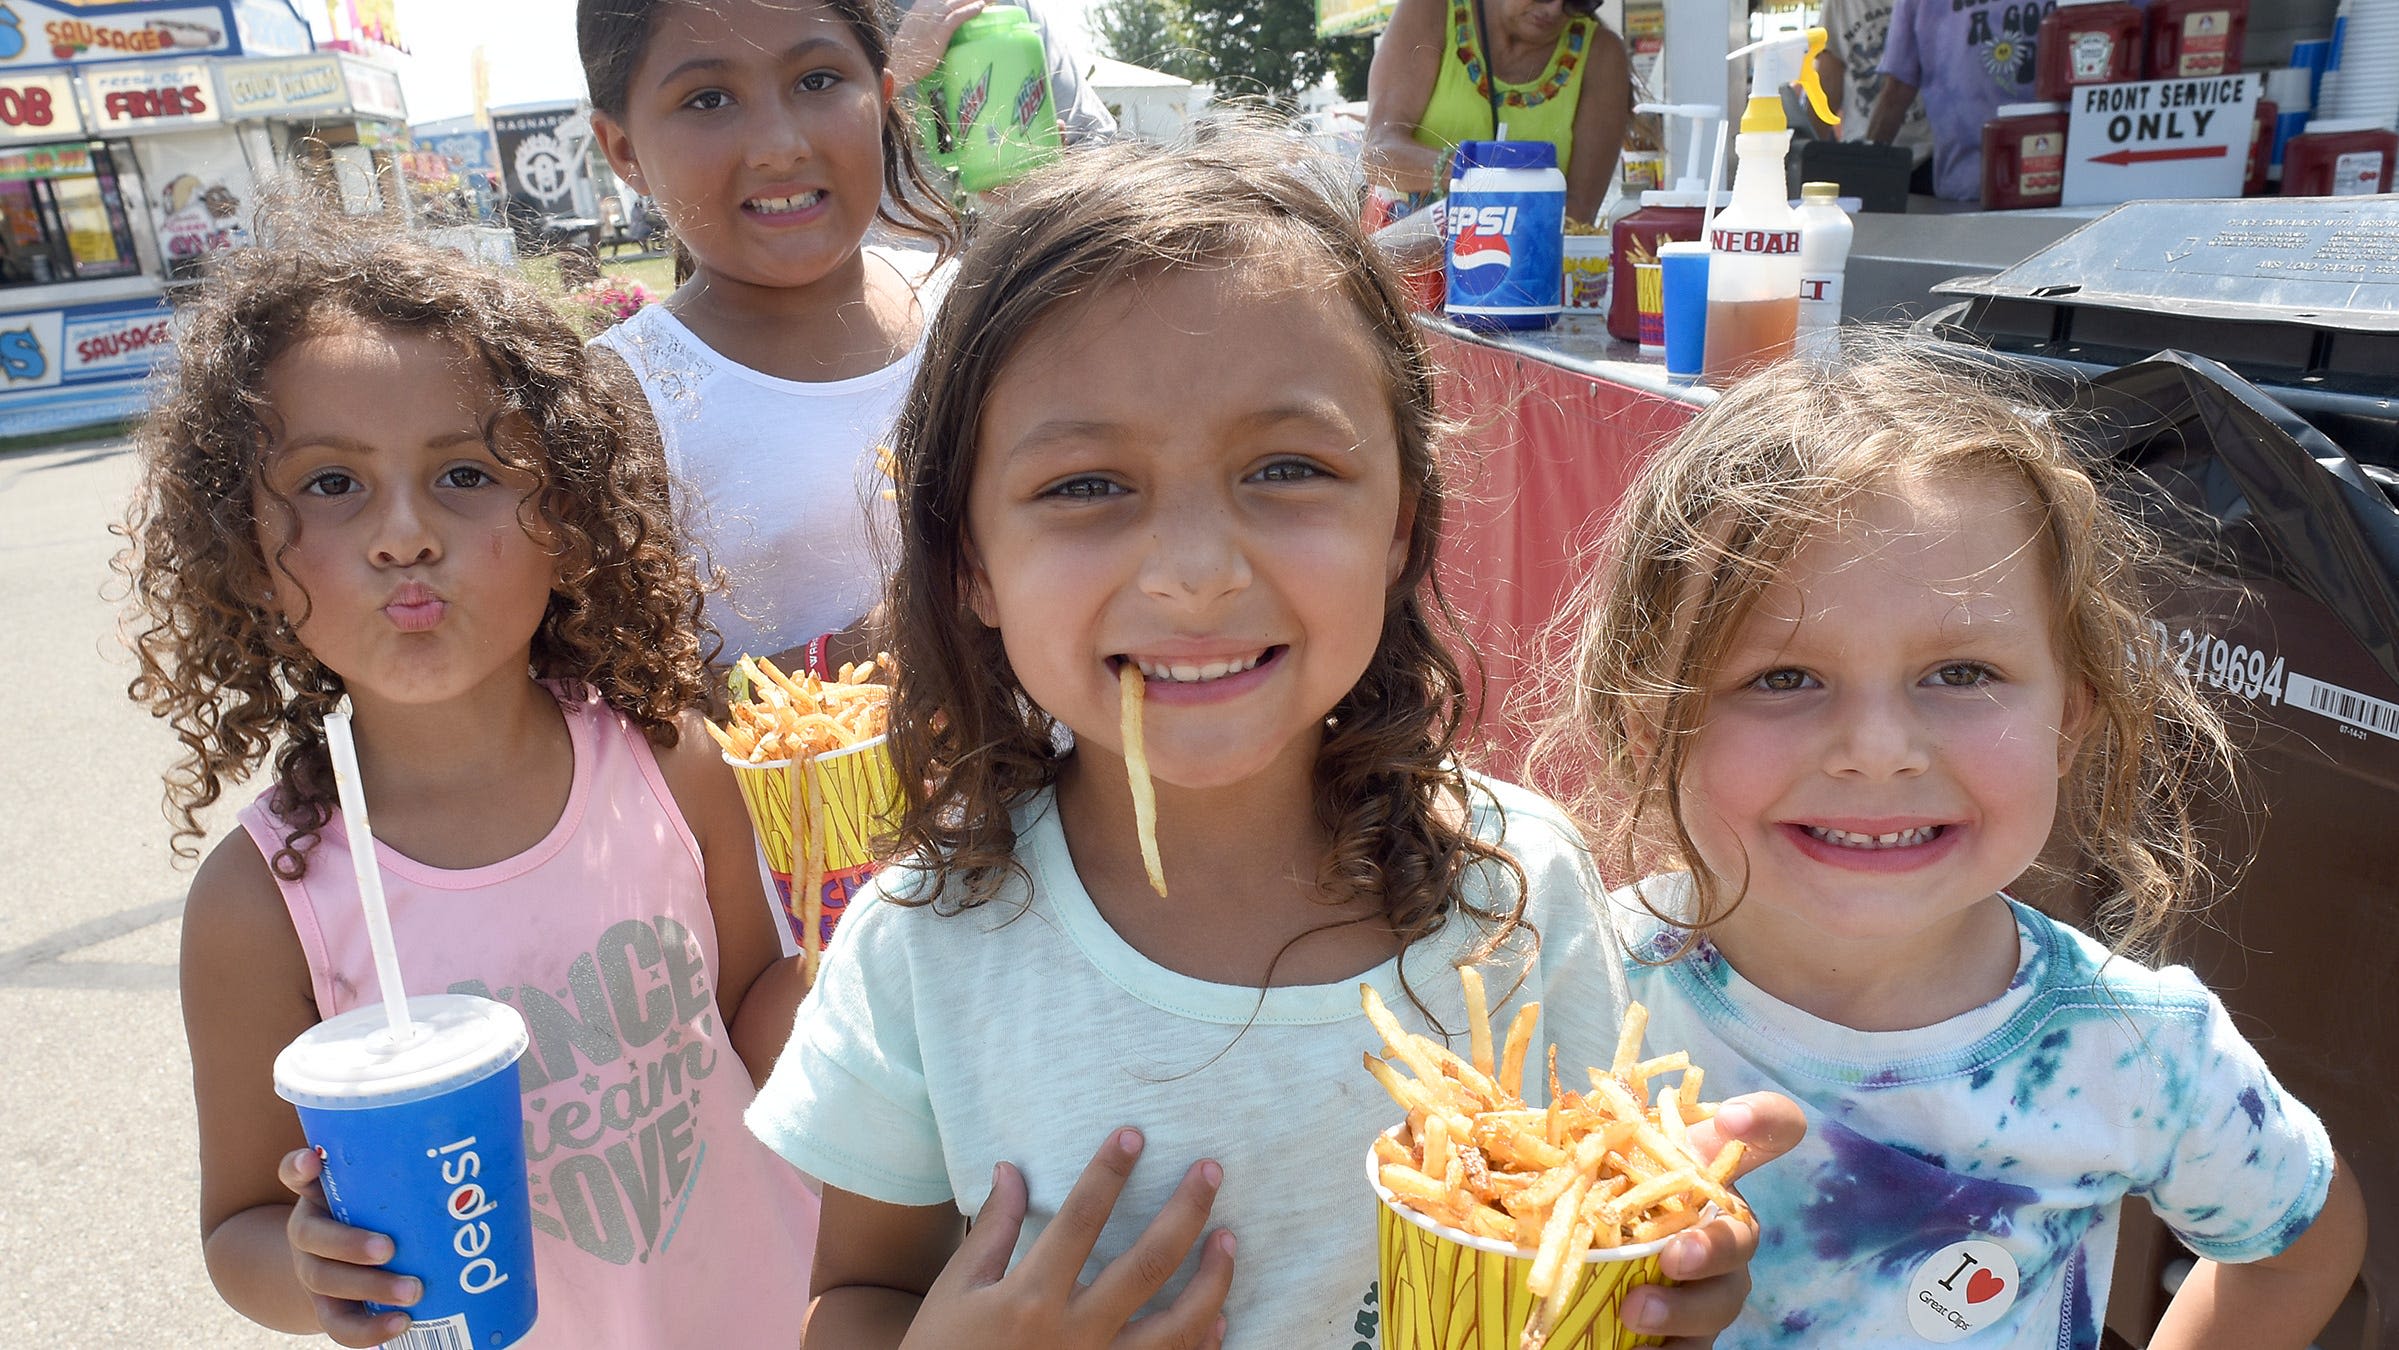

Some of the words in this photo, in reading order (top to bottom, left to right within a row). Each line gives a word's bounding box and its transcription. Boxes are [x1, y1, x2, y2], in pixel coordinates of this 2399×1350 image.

[45, 20, 161, 52] SAUSAGE
[2003, 3, 2055, 36] GO
[105, 85, 207, 120] FRIES
[2085, 85, 2151, 113] FRONT
[2160, 79, 2245, 109] SERVICE
[2107, 109, 2216, 143] ONLY
[2173, 628, 2286, 707] 219694
[531, 1100, 695, 1265] OVE
[426, 1136, 510, 1295] pepsi
[1937, 1252, 1978, 1292] I
[1918, 1290, 1949, 1317] Great
[1947, 1310, 1973, 1331] Clips
